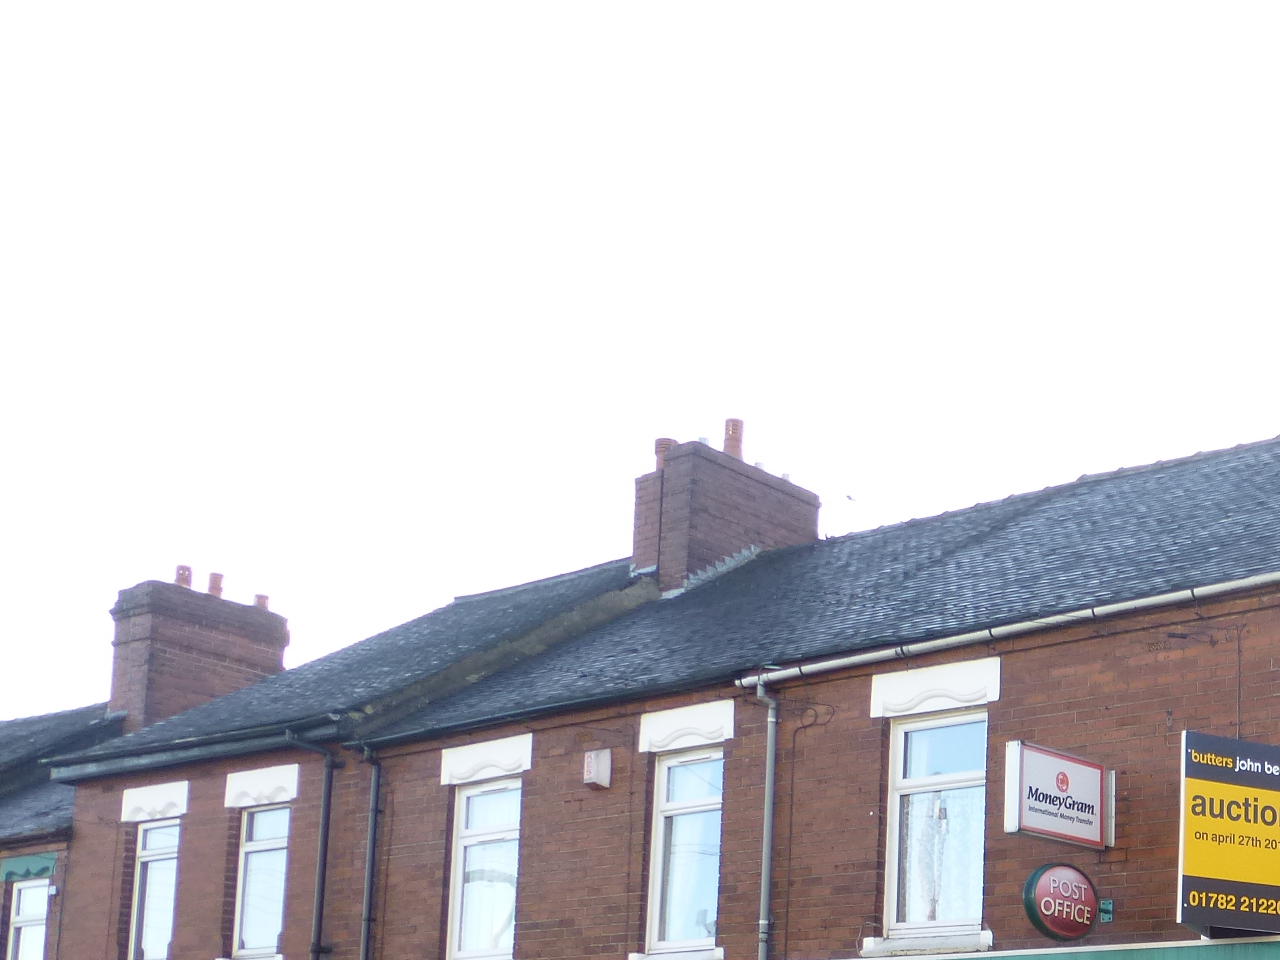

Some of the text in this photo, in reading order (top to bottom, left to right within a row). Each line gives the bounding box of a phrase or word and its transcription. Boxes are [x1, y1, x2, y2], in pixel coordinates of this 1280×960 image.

[1191, 749, 1233, 768] butters
[1234, 756, 1262, 773] john
[1027, 785, 1095, 815] MoneyGram
[1028, 805, 1059, 818] International
[1060, 812, 1075, 824] Money
[1194, 831, 1209, 841] on
[1211, 833, 1236, 846] april
[1238, 835, 1262, 848] 27th
[1050, 876, 1088, 902] POST
[1189, 890, 1236, 910] 01782
[1040, 896, 1091, 925] OFFICE
